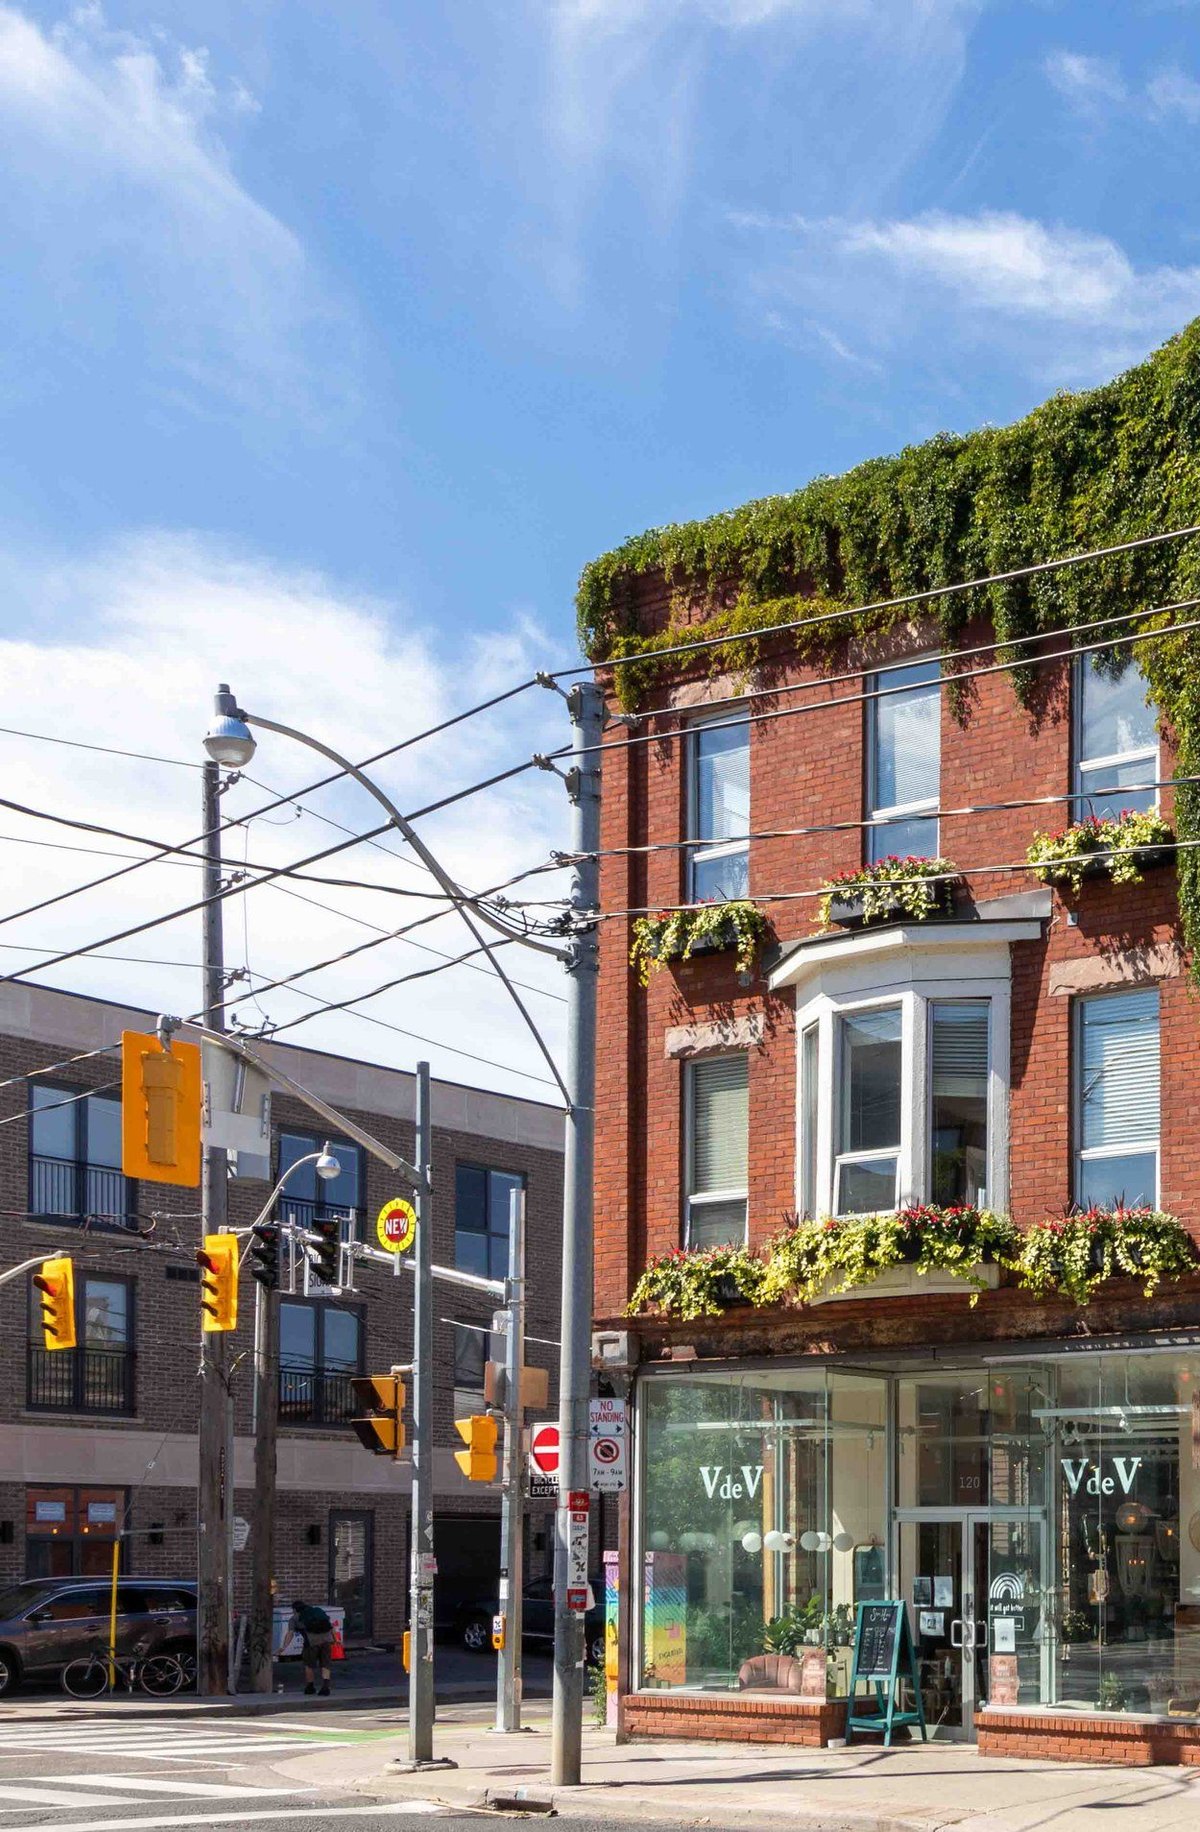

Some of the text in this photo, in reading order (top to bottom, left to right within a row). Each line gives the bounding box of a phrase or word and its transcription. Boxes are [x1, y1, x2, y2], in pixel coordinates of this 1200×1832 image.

[385, 1218, 408, 1235] NEW
[600, 1401, 614, 1411] NO
[590, 1412, 624, 1423] STANDING
[699, 1465, 764, 1499] VdeV
[960, 1476, 980, 1489] 120
[1060, 1457, 1142, 1495] VdeV
[1011, 1603, 1024, 1611] better
